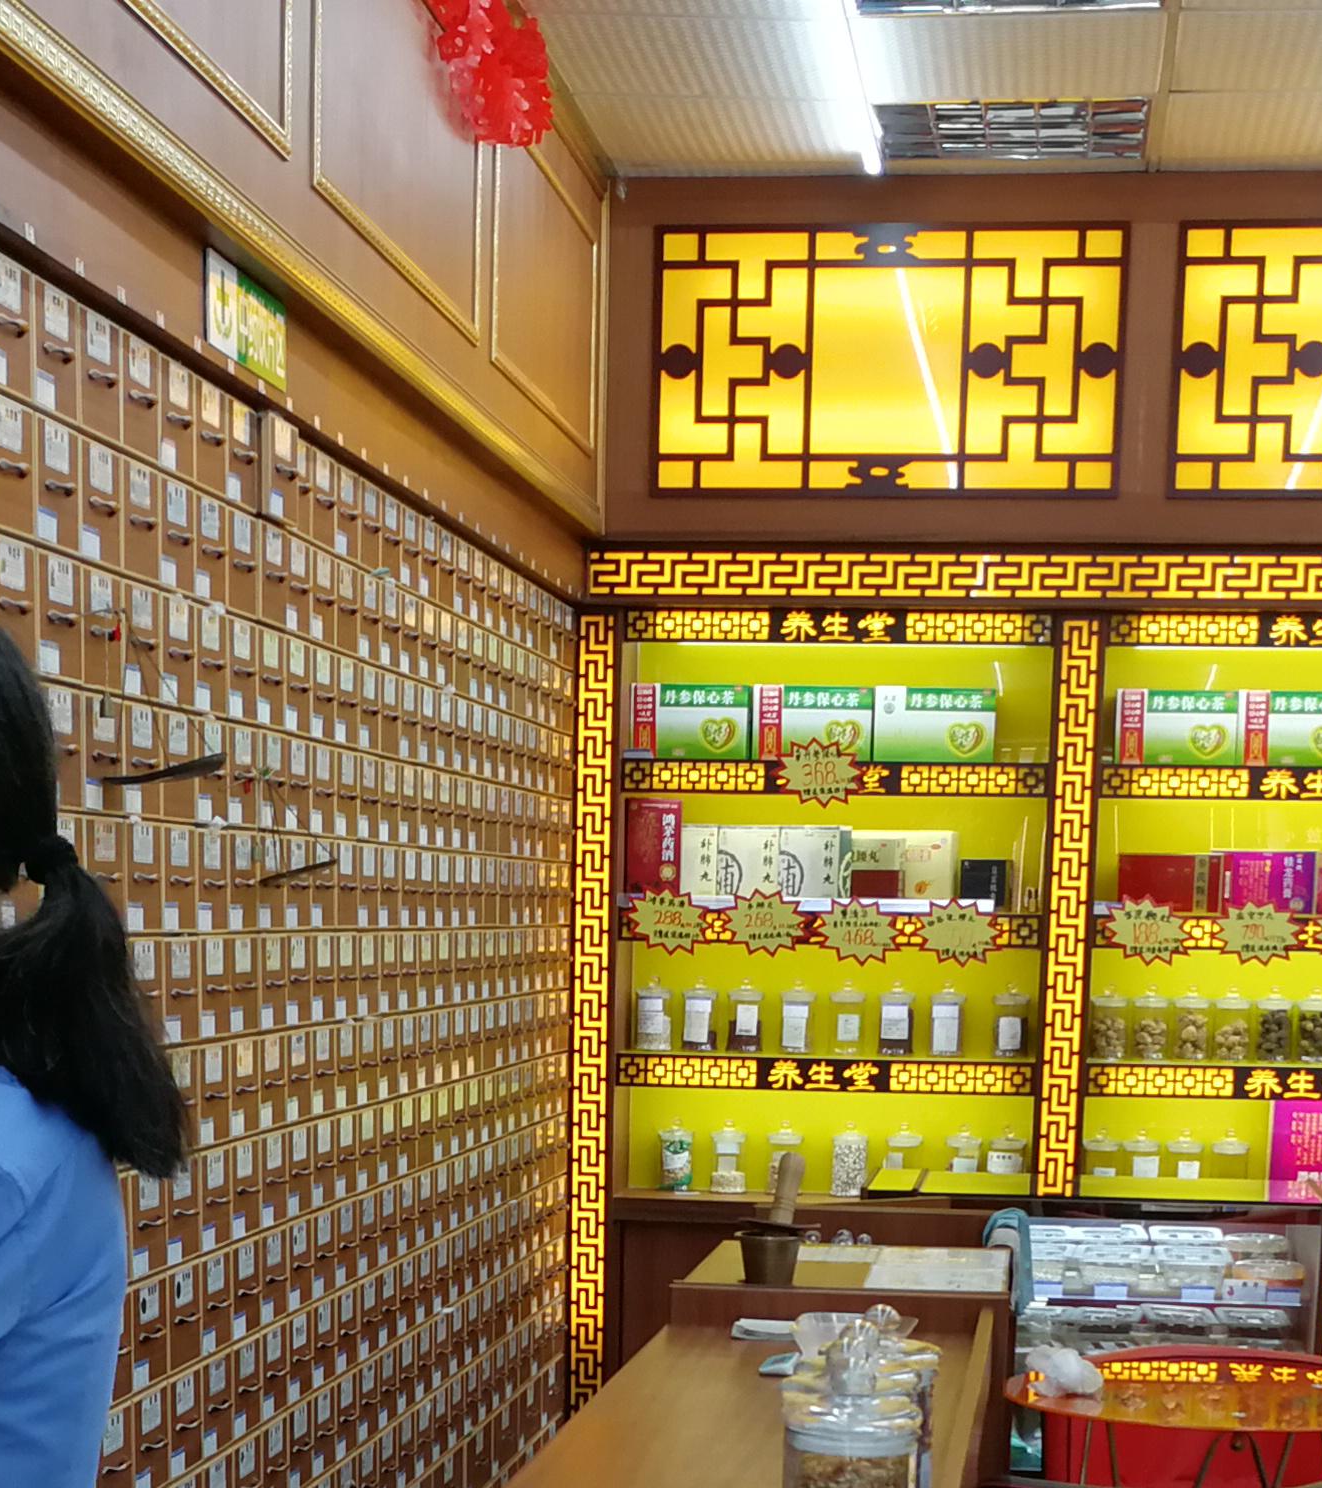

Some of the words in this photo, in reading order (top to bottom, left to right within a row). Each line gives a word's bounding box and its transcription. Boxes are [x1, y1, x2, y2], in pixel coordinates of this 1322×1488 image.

[779, 610, 896, 644] 养生堂
[664, 688, 735, 707] 丹参保心茶
[788, 690, 861, 709] 丹参保心茶
[908, 691, 984, 710] 丹参保心茶
[1150, 694, 1226, 713] 丹参保心茶
[802, 760, 837, 787] 368
[700, 837, 713, 884] 补肺丸
[762, 837, 775, 885] 补肺丸
[822, 838, 835, 886] 补肺丸
[653, 909, 683, 926] 288
[744, 912, 774, 929] 268
[842, 928, 875, 947] 468
[768, 1059, 881, 1092] 养生堂
